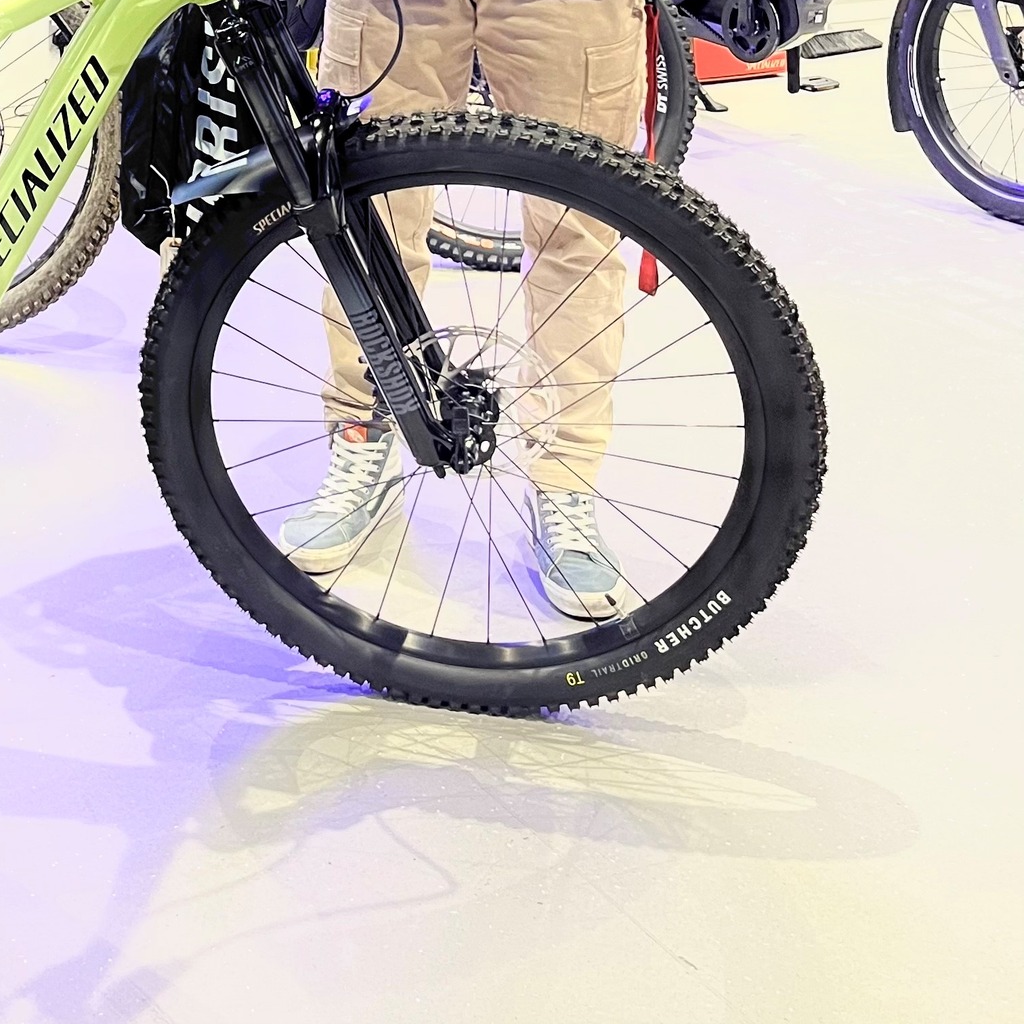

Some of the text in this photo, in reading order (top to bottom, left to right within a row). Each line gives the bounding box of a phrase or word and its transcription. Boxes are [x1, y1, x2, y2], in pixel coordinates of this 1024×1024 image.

[656, 54, 668, 114] DT SWISS
[350, 308, 420, 415] ROCKSHOX
[653, 589, 732, 654] BUTCHER
[565, 670, 586, 686] T9
